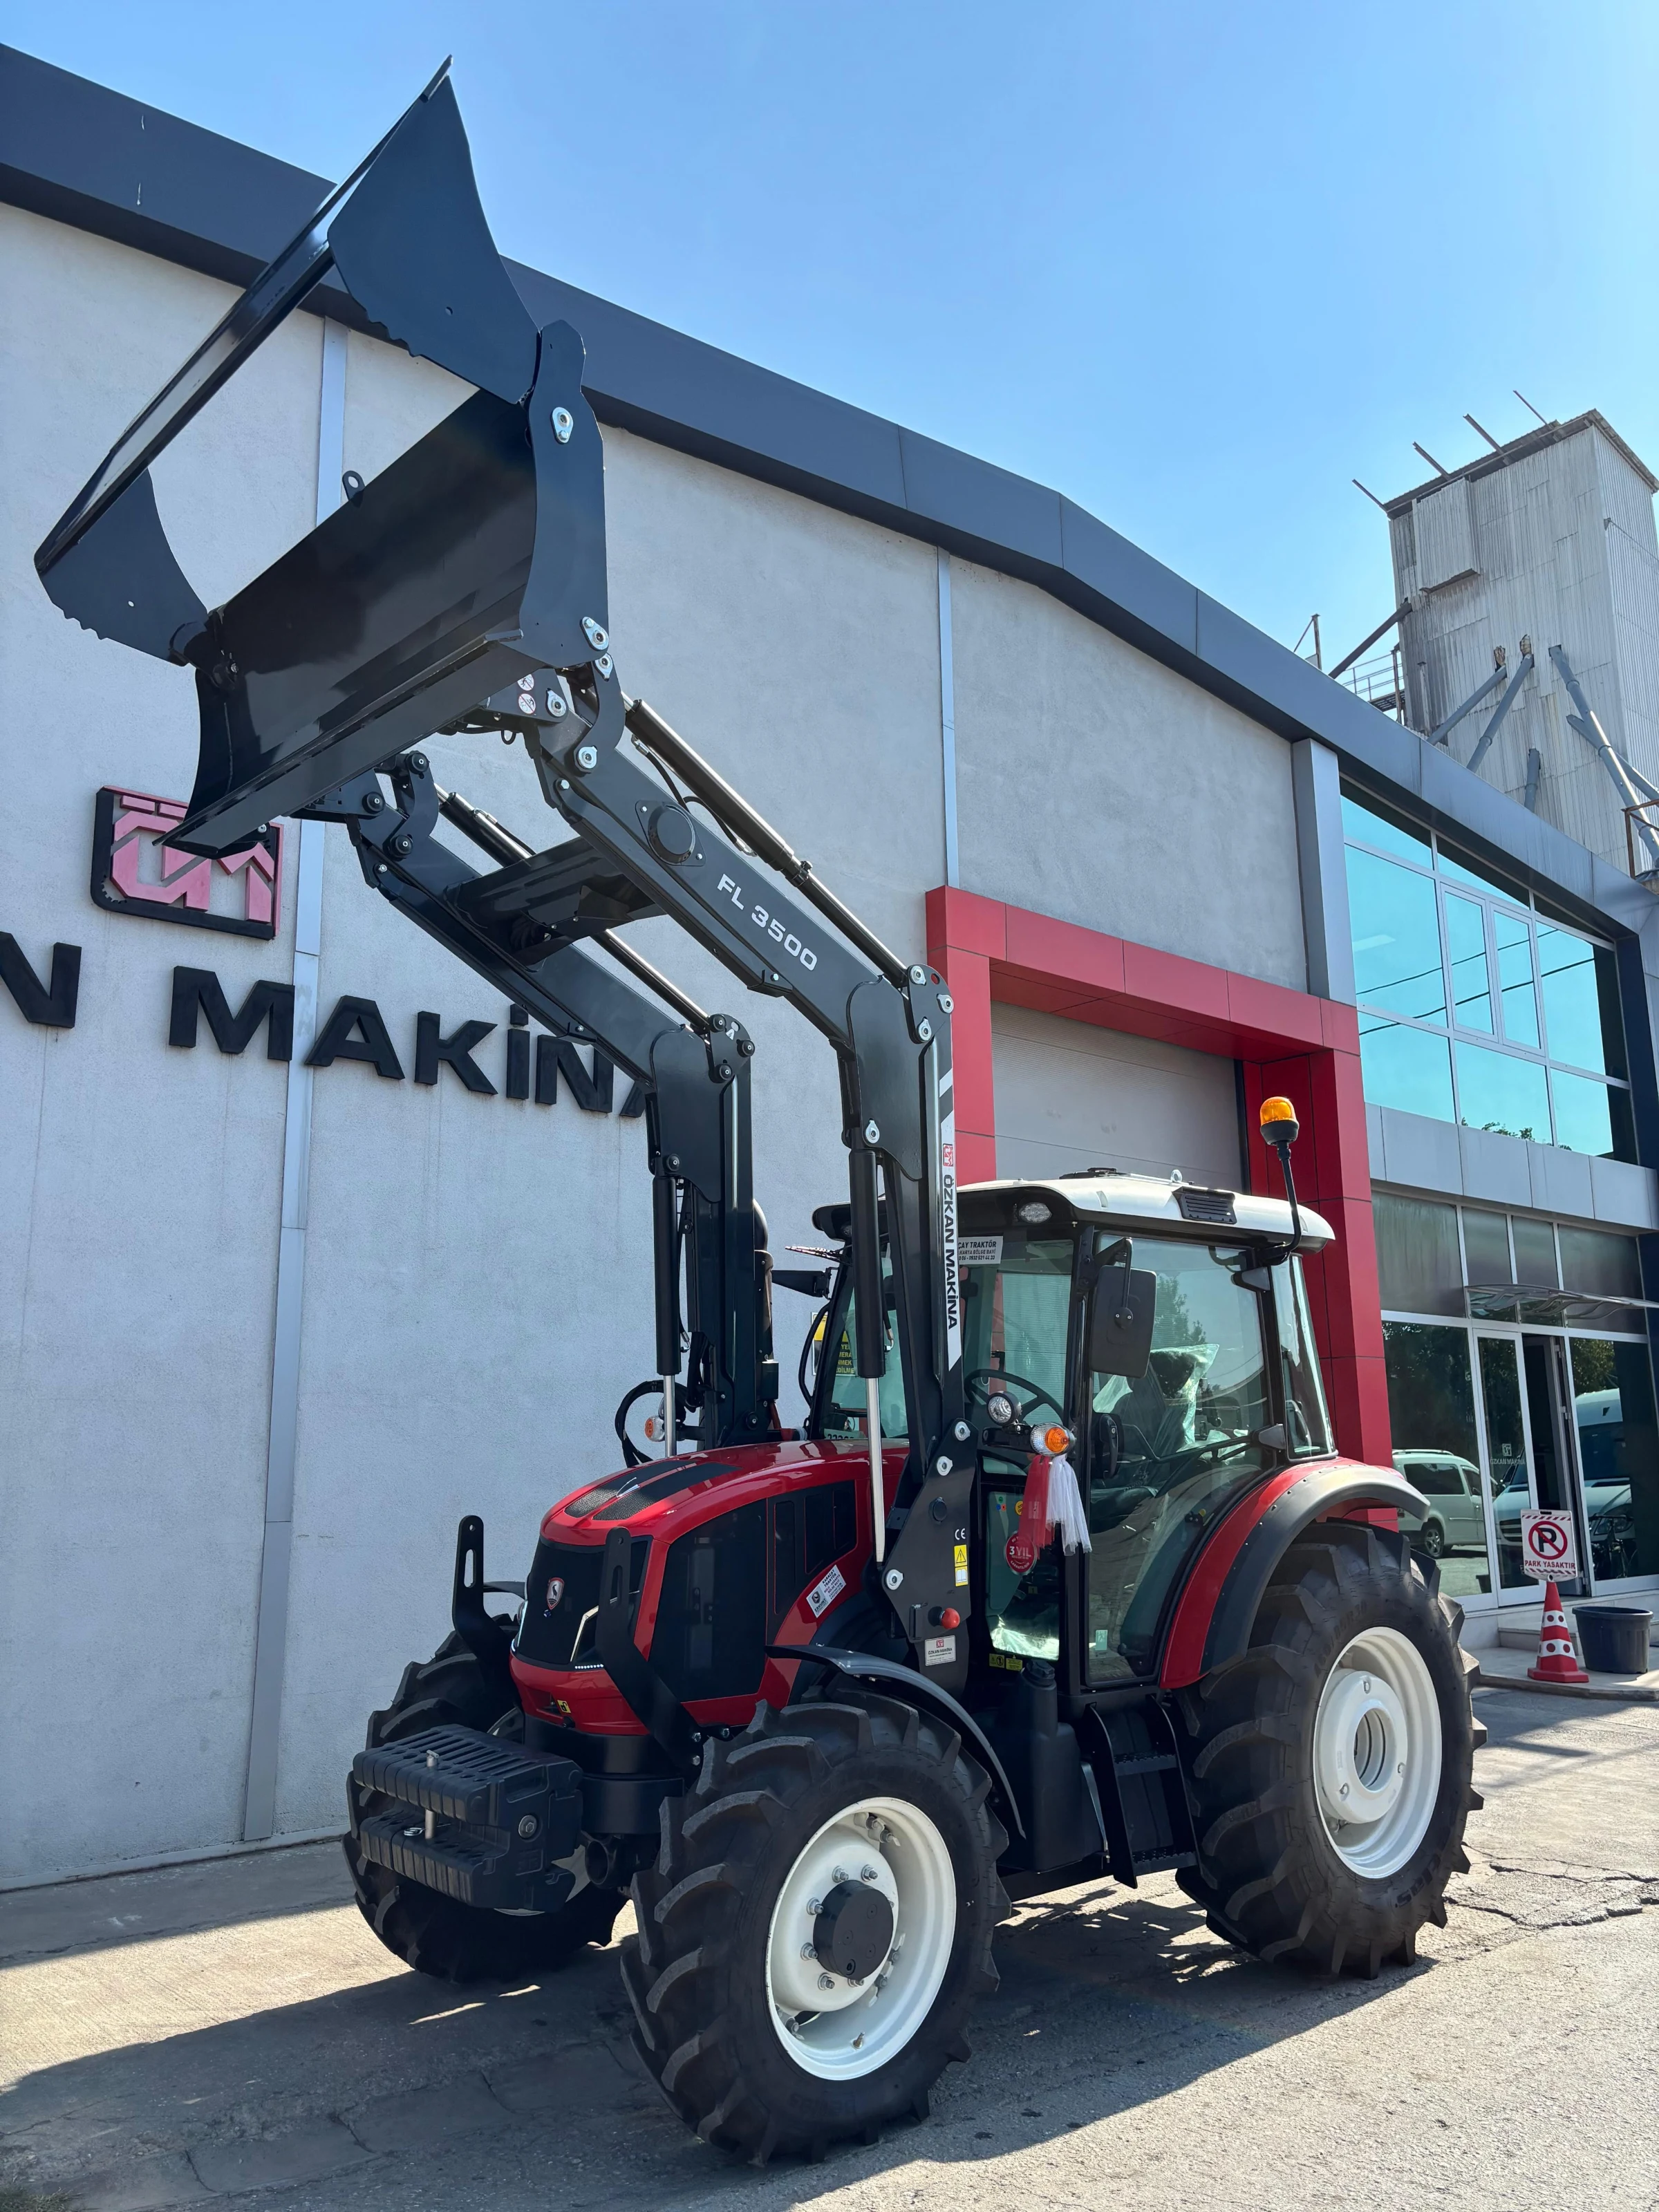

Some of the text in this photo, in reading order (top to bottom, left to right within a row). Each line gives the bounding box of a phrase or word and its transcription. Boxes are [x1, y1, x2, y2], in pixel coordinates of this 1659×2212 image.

[717, 873, 818, 971] FL 3500
[169, 965, 648, 1118] MAKİN
[944, 1174, 955, 1243] ÖZKAN
[970, 1239, 997, 1248] TRAKTÖR
[946, 1249, 958, 1330] MAKİNA
[1009, 1546, 1031, 1557] 3 YIL
